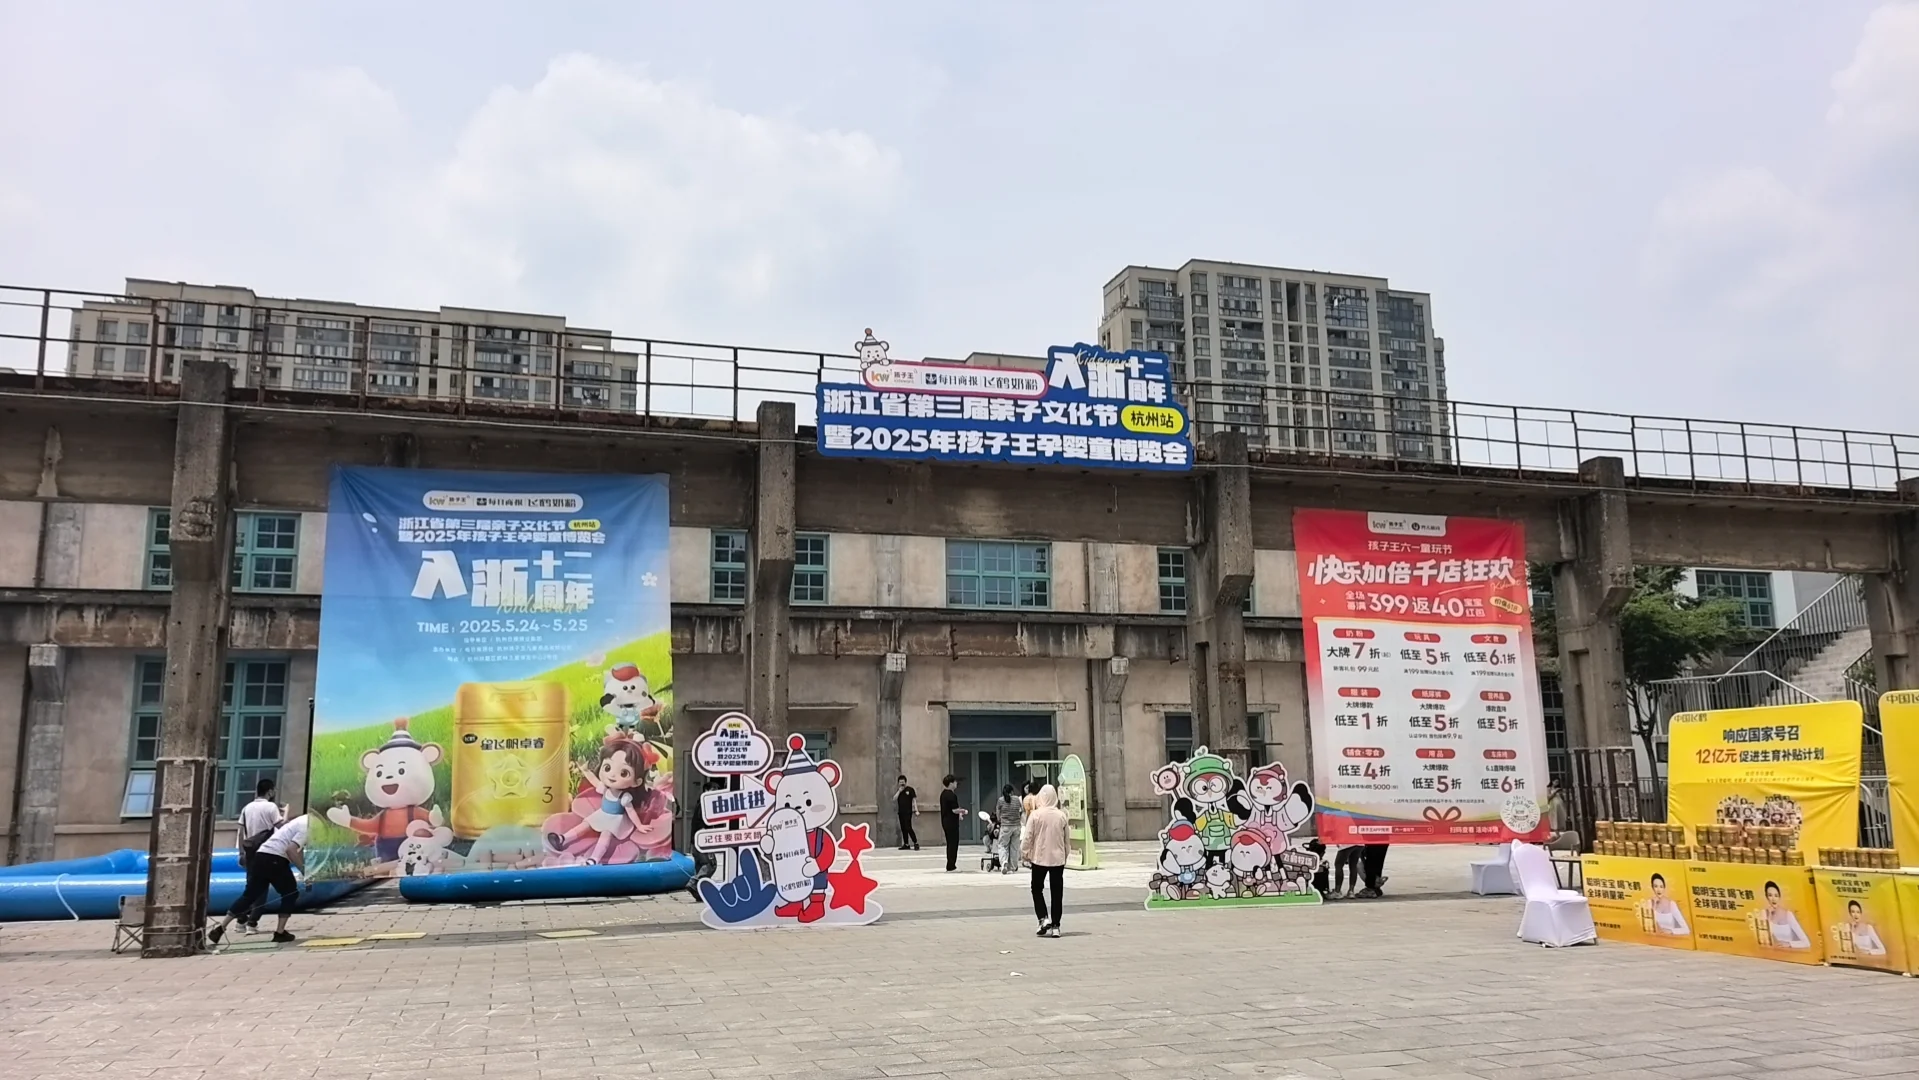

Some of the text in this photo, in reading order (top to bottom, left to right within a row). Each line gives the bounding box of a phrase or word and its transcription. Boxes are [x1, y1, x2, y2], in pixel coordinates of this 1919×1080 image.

[938, 374, 978, 386] 每日商报
[984, 376, 1038, 391] 飞鹤奶粉
[823, 389, 1174, 428] 浙江省第三届亲子文化节 杭州站
[824, 423, 1188, 465] 暨2025年孩子王孕婴童博览会
[528, 498, 576, 508] 飞鹤奶粉
[398, 517, 596, 531] 浙江省第三届亲子文化节 杭州站
[398, 530, 606, 544] 暨2025年孩子王孕婴童博览会
[1368, 541, 1453, 555] 孩子王六一童玩节
[1723, 724, 1800, 743] 响应国家号召
[481, 737, 545, 750] 星飞帆卓睿
[542, 786, 553, 804] 3
[712, 790, 766, 814] 由此进
